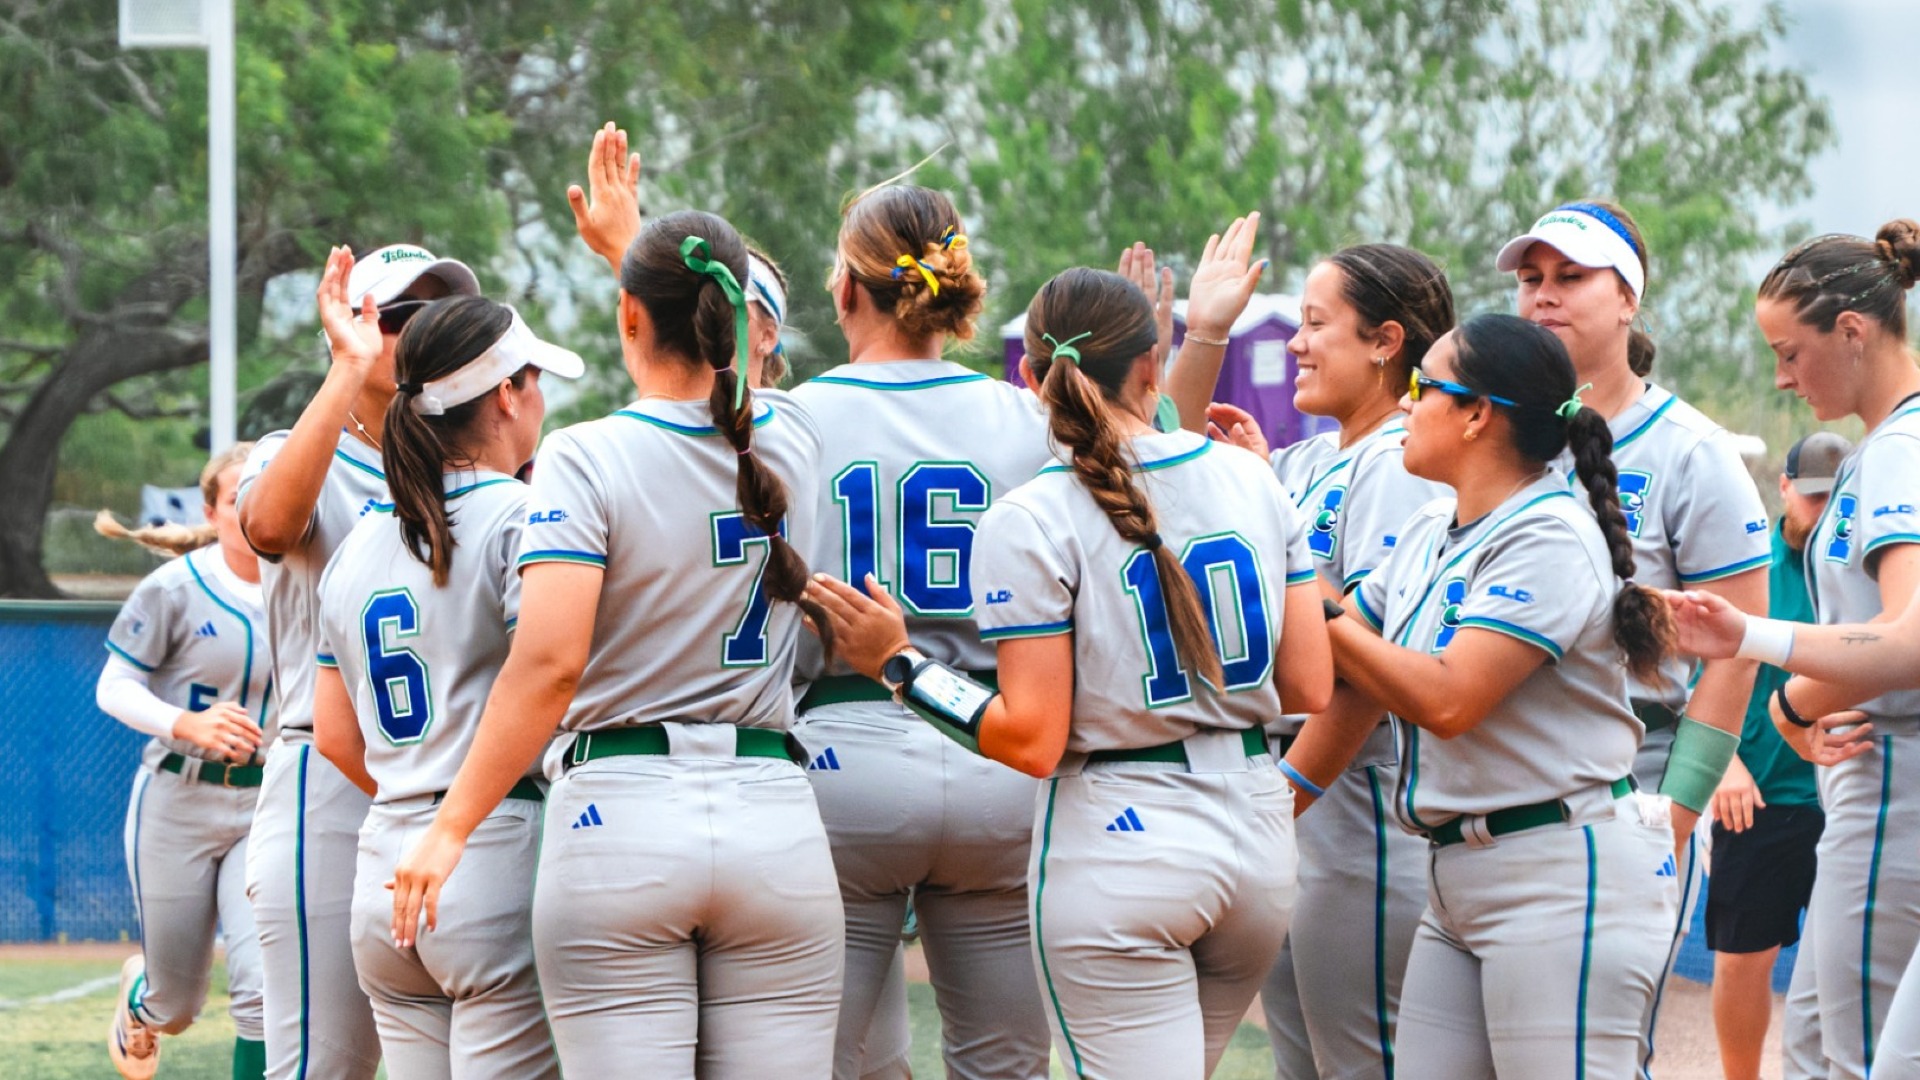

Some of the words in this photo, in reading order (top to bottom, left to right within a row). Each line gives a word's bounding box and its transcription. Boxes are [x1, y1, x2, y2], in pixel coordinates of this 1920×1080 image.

[528, 510, 563, 526] SLC
[709, 511, 789, 669] 7
[831, 461, 991, 618] 16
[360, 587, 434, 748] 6
[1120, 530, 1275, 710] 10
